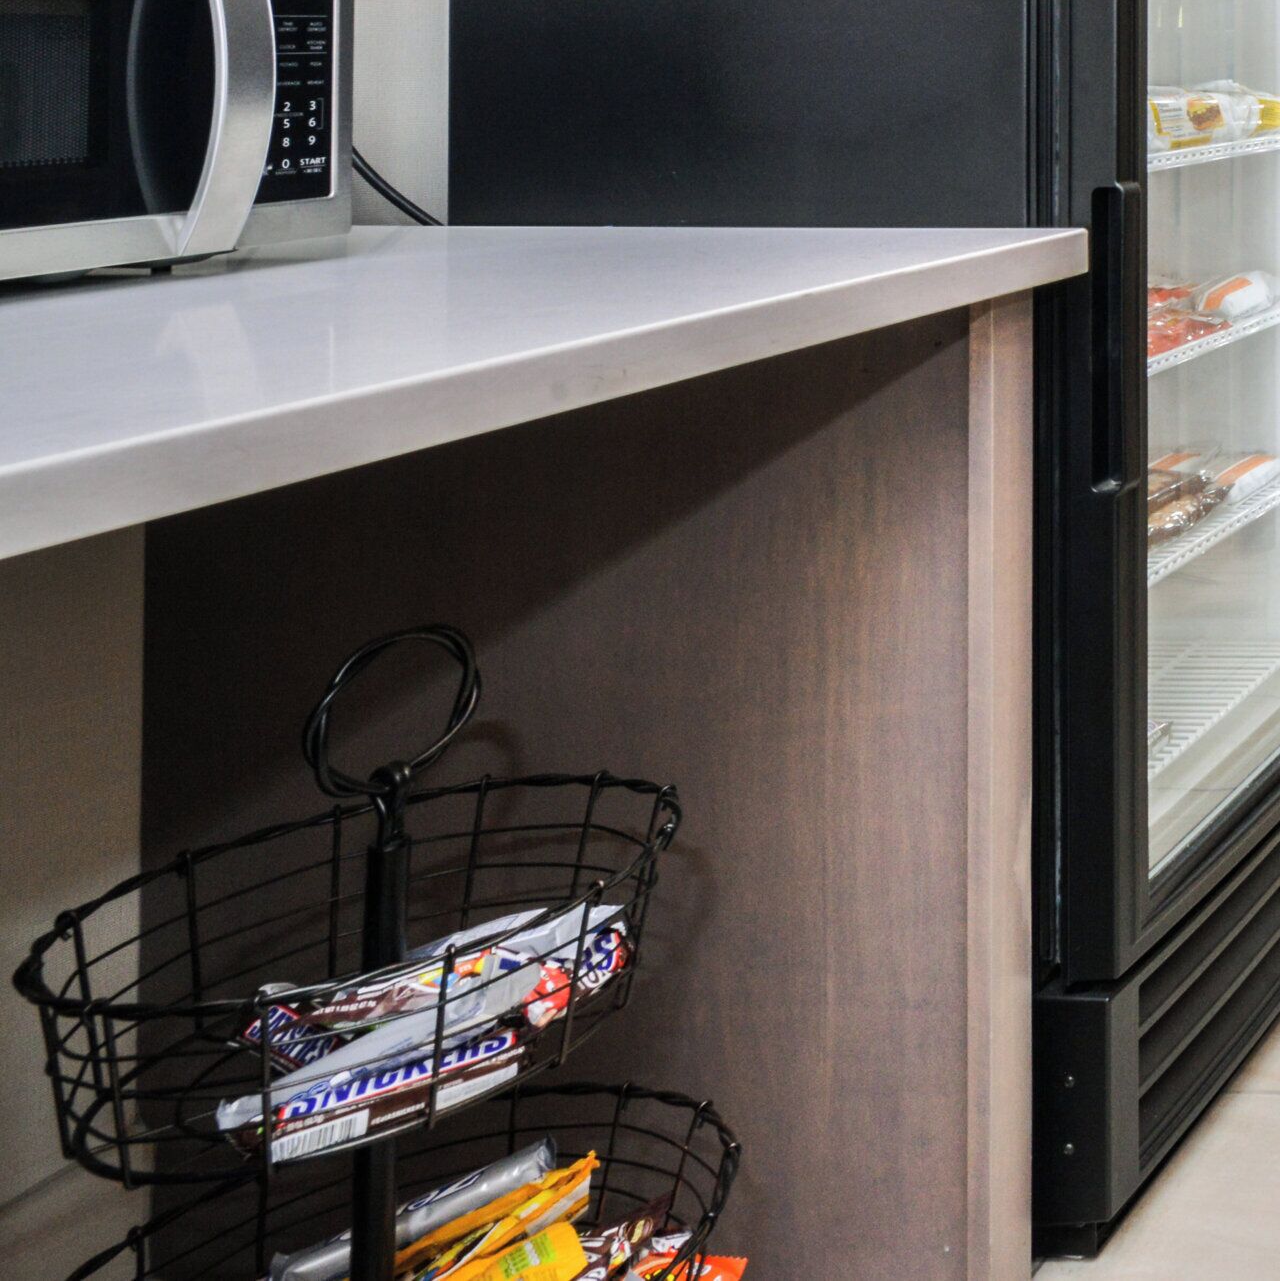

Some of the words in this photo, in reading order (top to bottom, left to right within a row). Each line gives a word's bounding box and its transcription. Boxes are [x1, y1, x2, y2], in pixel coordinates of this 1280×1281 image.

[283, 101, 291, 112] 2
[309, 100, 317, 111] 3
[283, 118, 290, 129] 5
[308, 117, 316, 128] 6
[282, 137, 290, 148] 8
[308, 135, 316, 146] 9
[281, 158, 290, 169] 0
[300, 157, 326, 166] START
